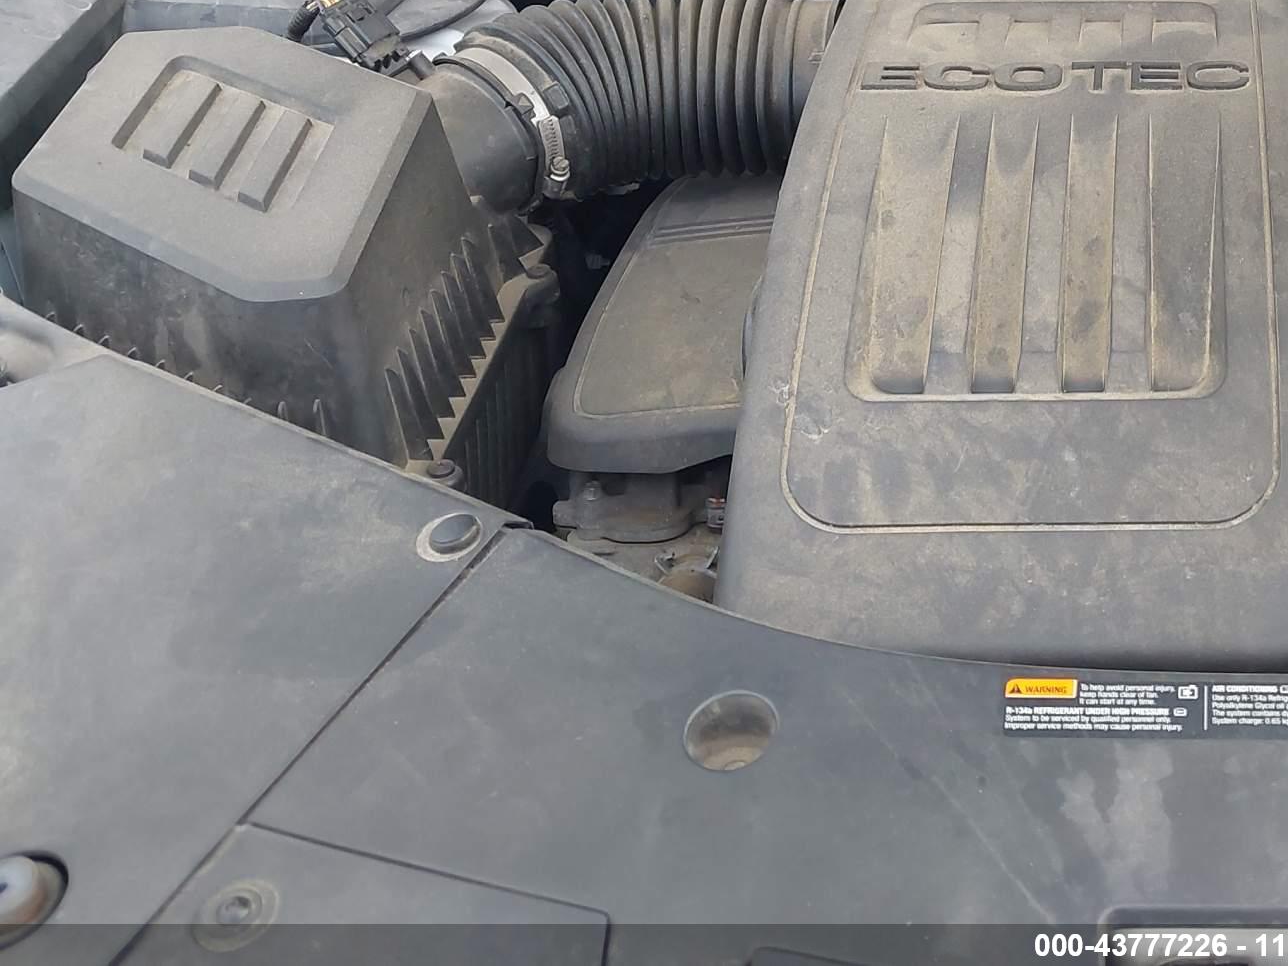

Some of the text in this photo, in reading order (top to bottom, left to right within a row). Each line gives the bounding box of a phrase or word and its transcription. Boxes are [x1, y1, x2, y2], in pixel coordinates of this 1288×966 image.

[861, 61, 1250, 91] ECOTEC
[1025, 685, 1067, 694] WARNING
[1090, 683, 1104, 692] help
